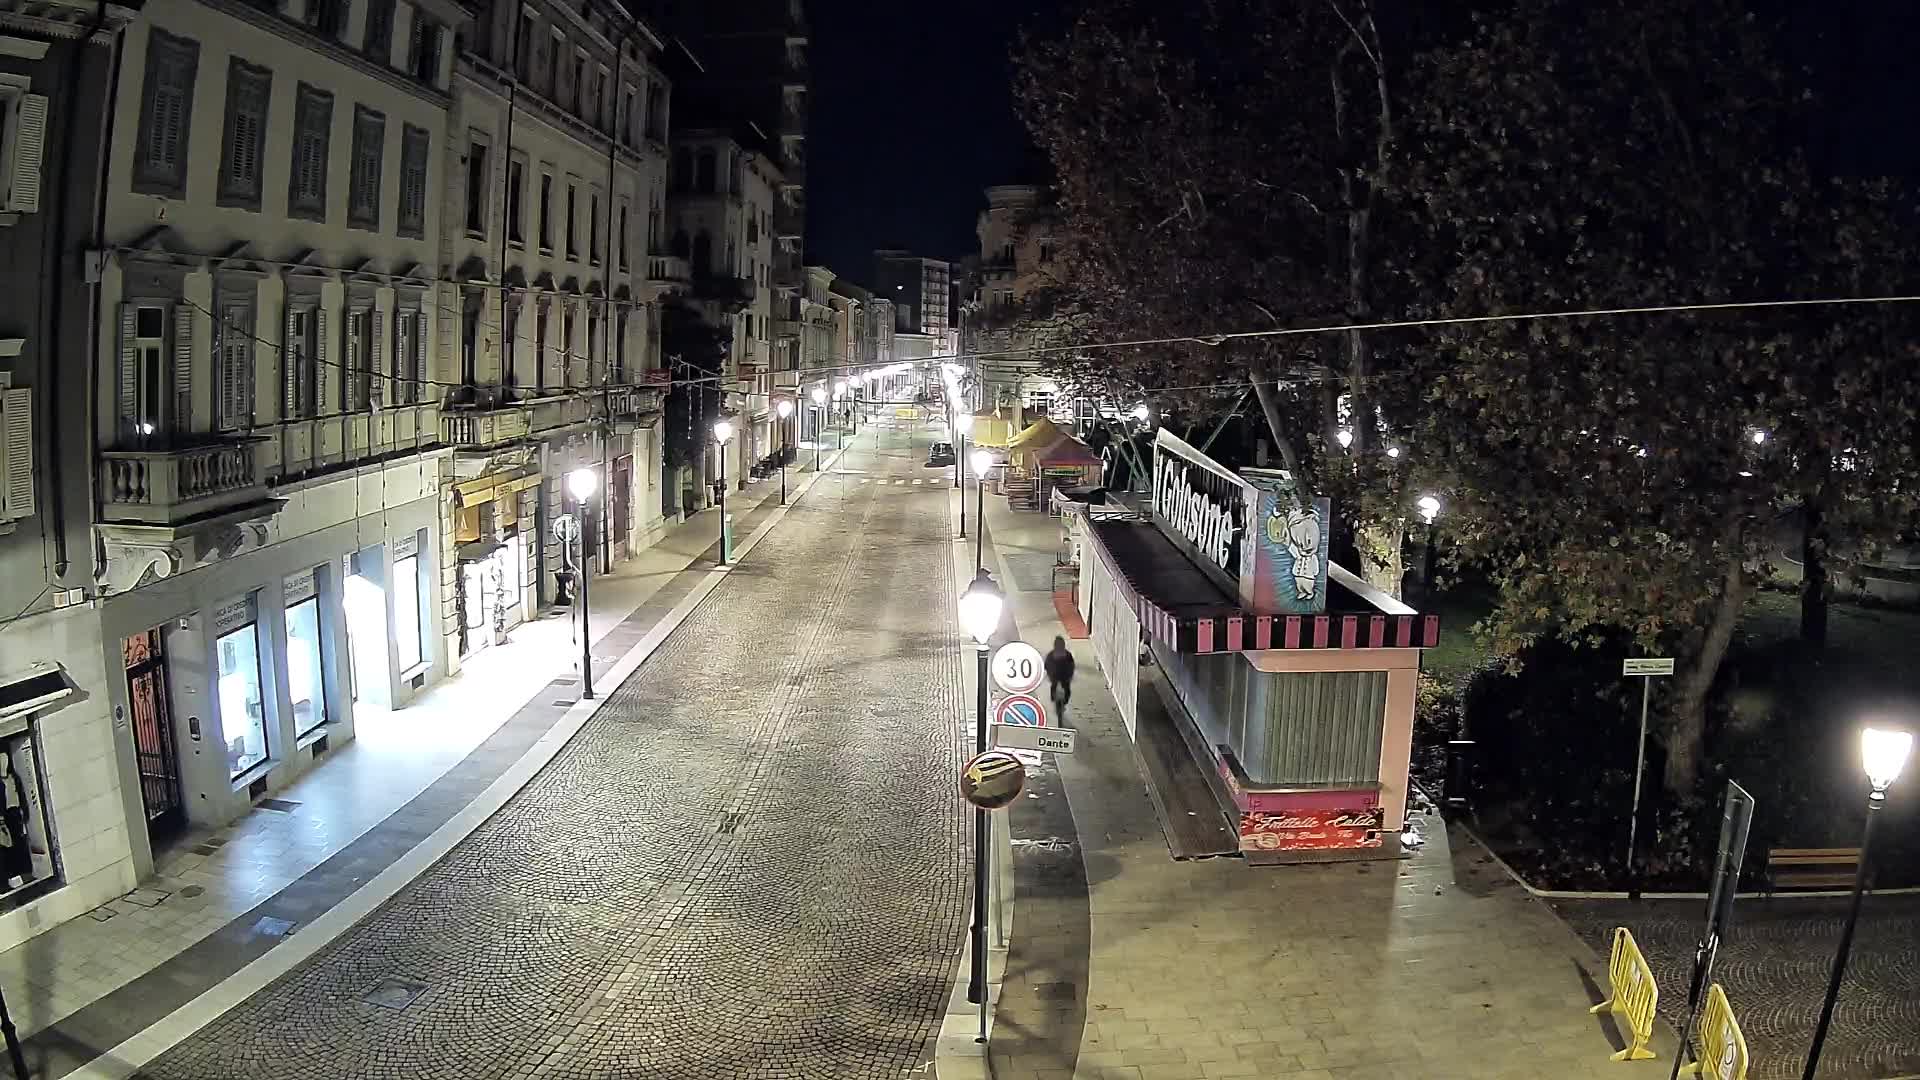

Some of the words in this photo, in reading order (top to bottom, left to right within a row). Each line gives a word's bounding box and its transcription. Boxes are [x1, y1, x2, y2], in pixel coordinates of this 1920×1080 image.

[1163, 459, 1232, 568] Golosone
[1006, 658, 1032, 679] 30
[1038, 737, 1070, 749] Dante
